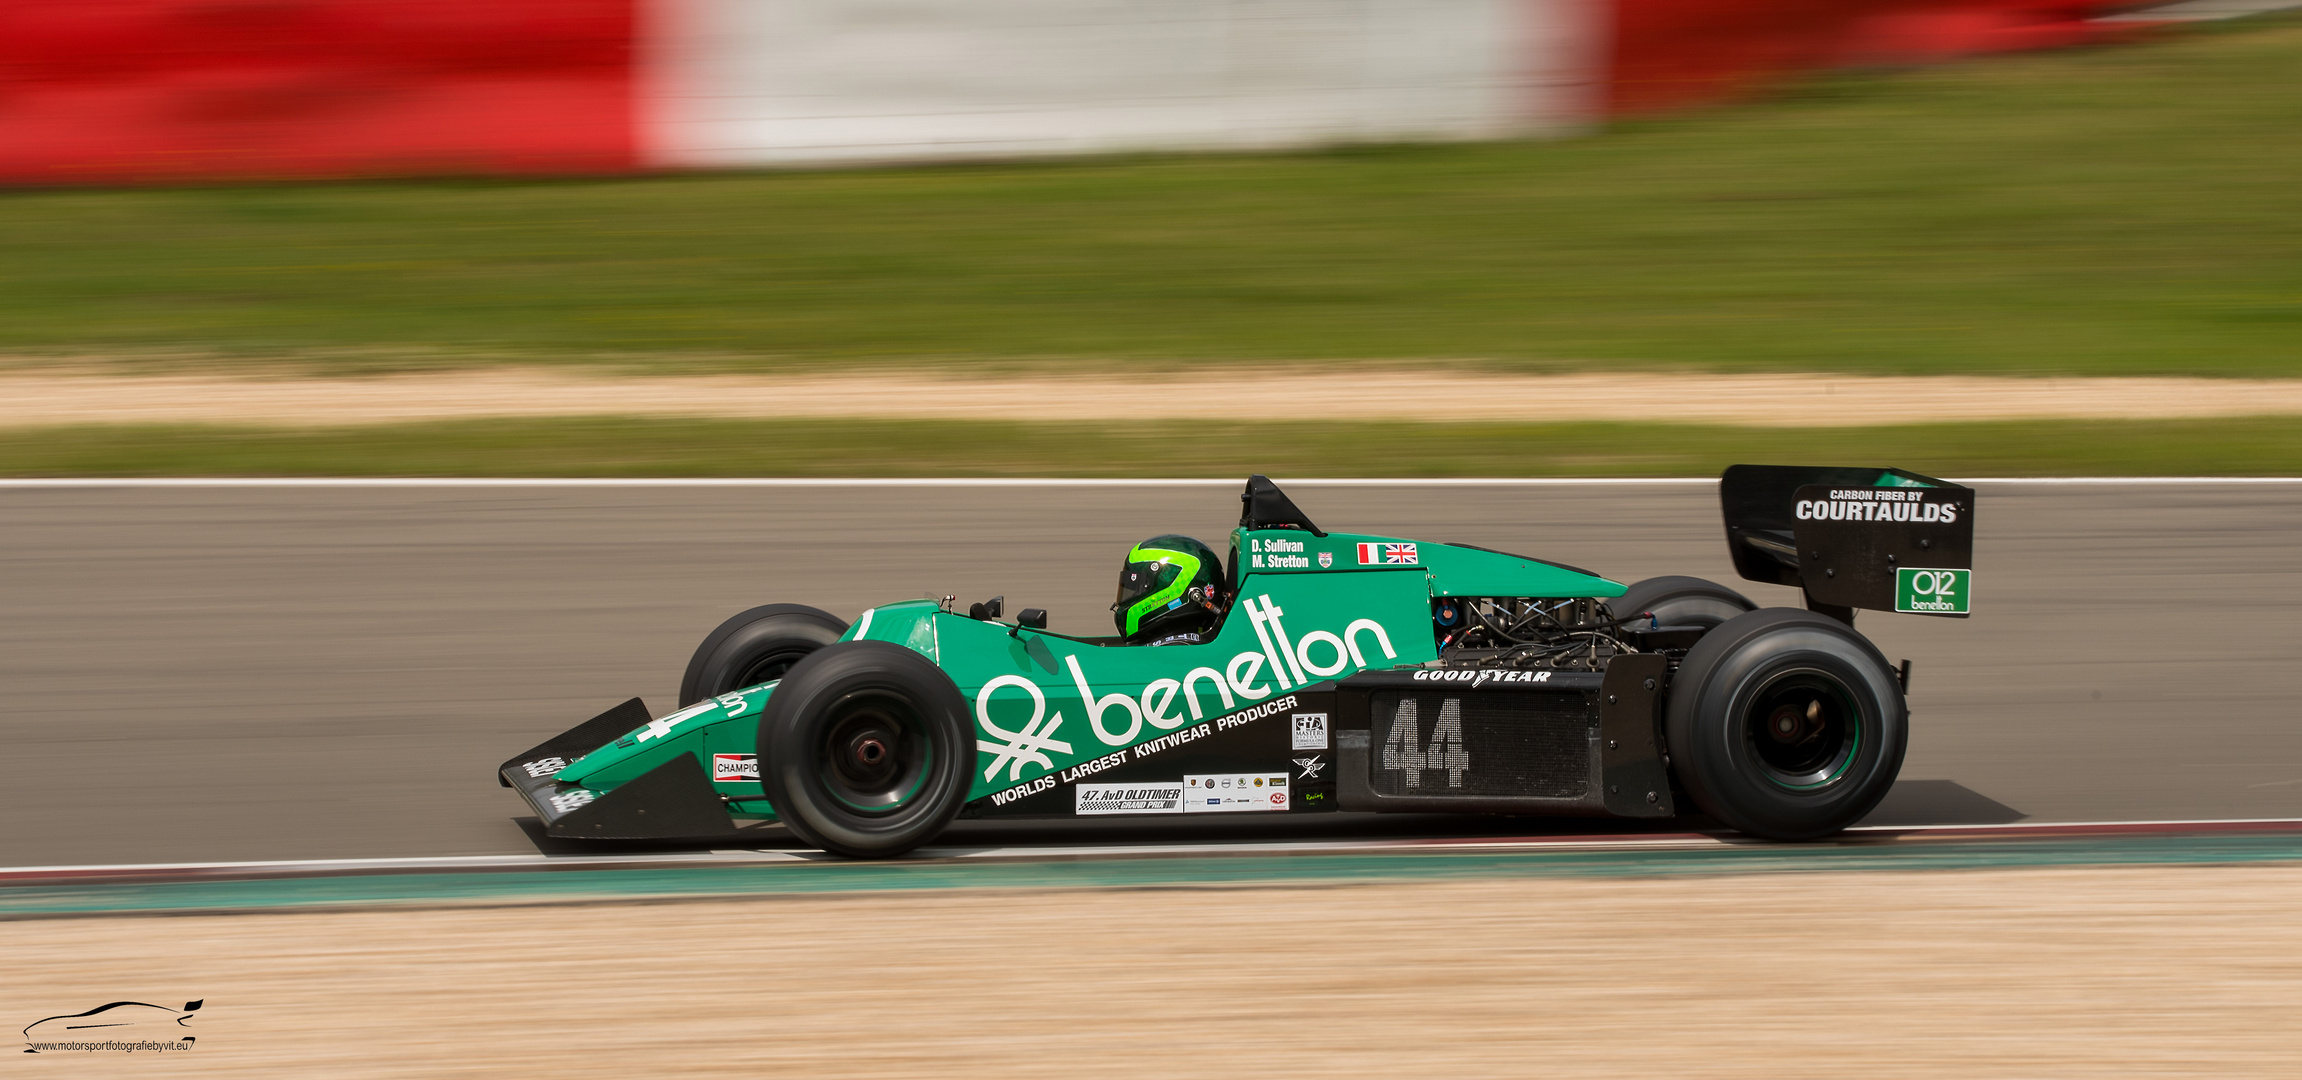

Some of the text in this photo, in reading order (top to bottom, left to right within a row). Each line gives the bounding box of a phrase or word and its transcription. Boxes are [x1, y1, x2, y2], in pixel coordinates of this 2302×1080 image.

[1830, 489, 1923, 501] CARBON FIBER BY
[1796, 500, 1957, 523] COURTAULDS
[1252, 539, 1303, 552] D. Sullivan
[1252, 554, 1309, 568] M. Stretton
[1911, 595, 1954, 611] benetton
[1065, 594, 1397, 746] benetton
[1383, 698, 1469, 787] 44
[991, 695, 1298, 807] WORLDS LARGEST KNITWEAR PRODUCER
[717, 763, 759, 773] CHAMPIO
[1082, 788, 1182, 801] 47. AvD OLDTIMER
[1121, 801, 1166, 809] GRAND PRIX
